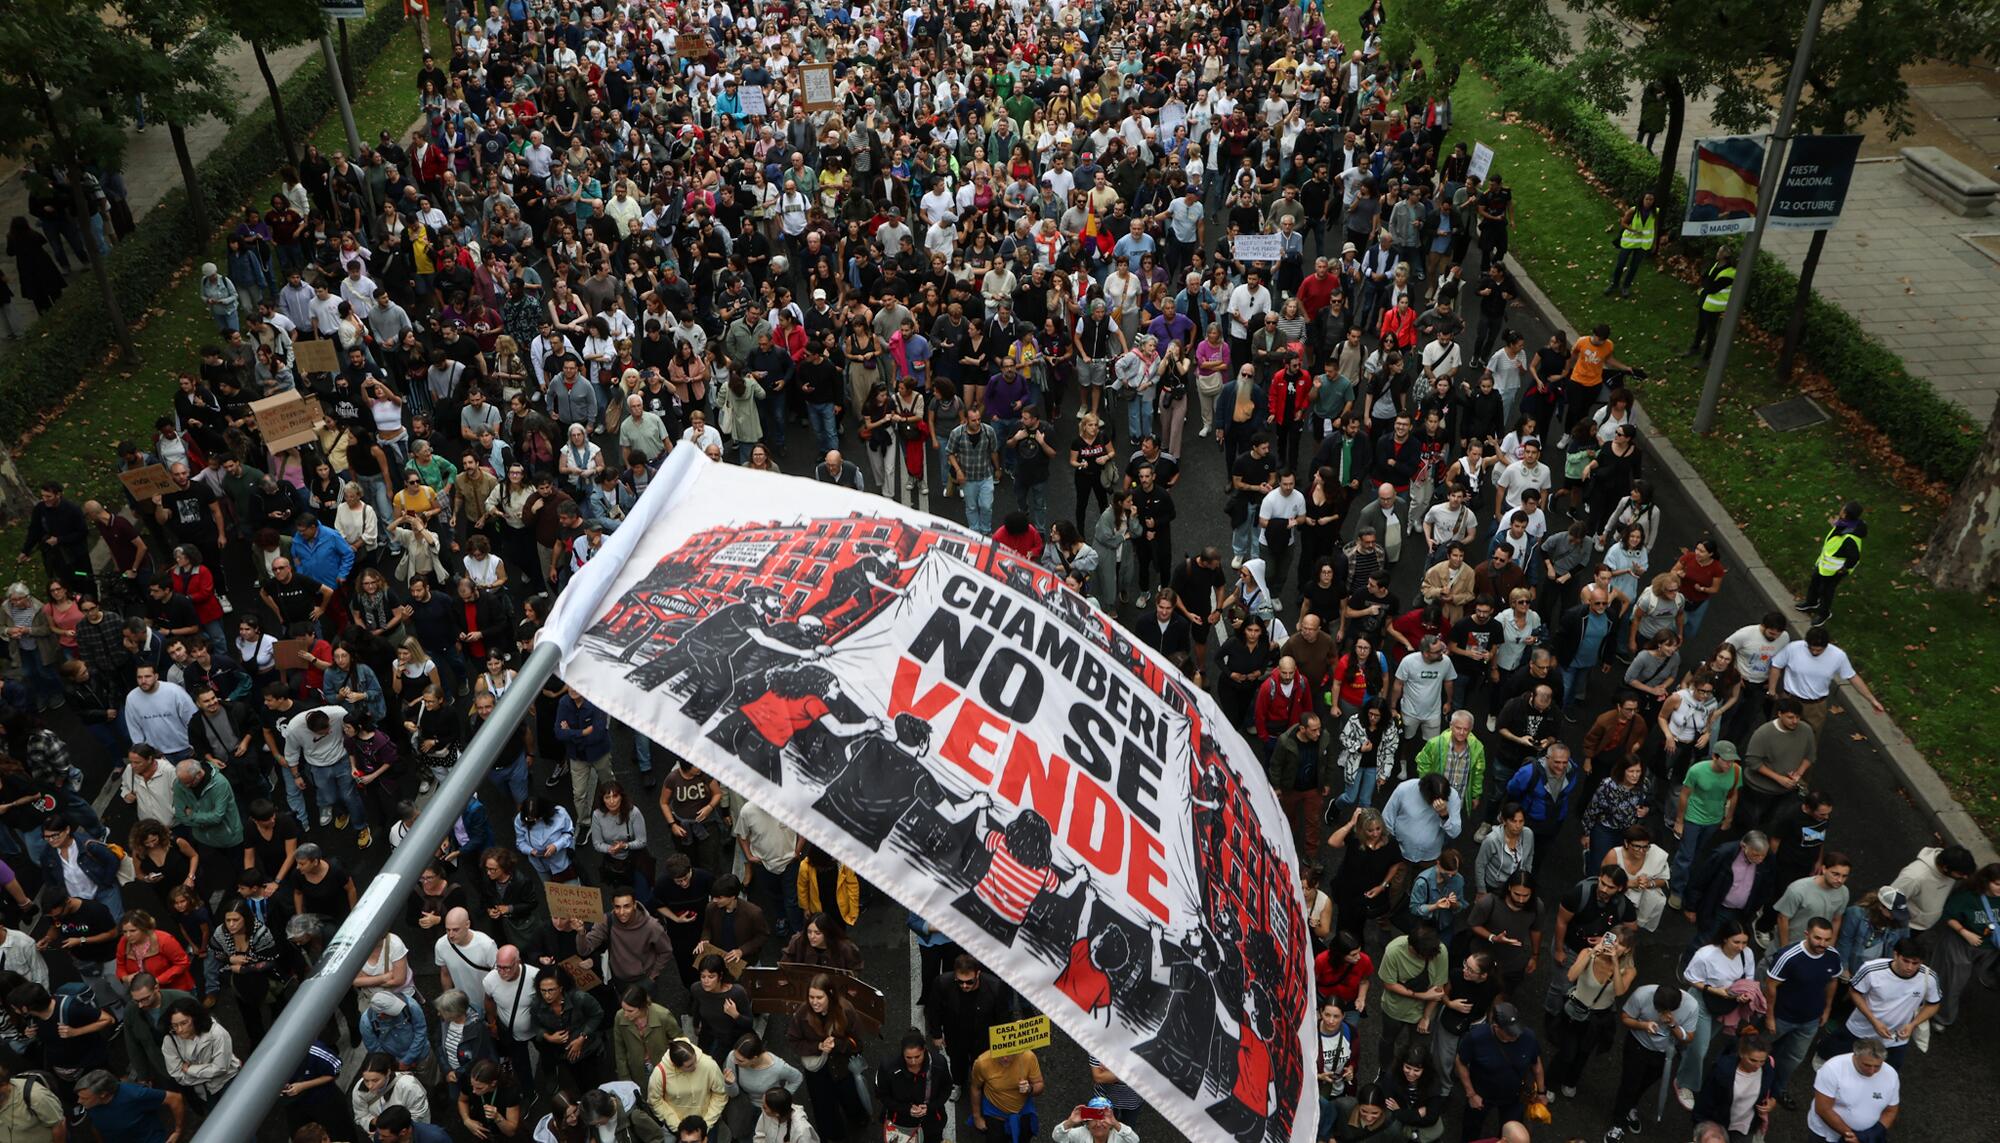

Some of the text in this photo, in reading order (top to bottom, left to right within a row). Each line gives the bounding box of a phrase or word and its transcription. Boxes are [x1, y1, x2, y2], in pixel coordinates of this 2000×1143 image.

[1790, 165, 1819, 175] FIESTA
[1786, 176, 1833, 186] NACIONAL
[1779, 200, 1835, 211] 12 OCTUBRE
[1709, 223, 1740, 232] MADRID
[941, 574, 1169, 764] CHAMBERÍ
[907, 605, 1163, 834] NO SE
[886, 655, 1170, 925] VENDE
[996, 1018, 1044, 1035] CASA, HOGAR
[1008, 1027, 1039, 1040] PLANETA
[992, 1040, 1017, 1050] DONDE
[1018, 1031, 1049, 1045] HABITAR
